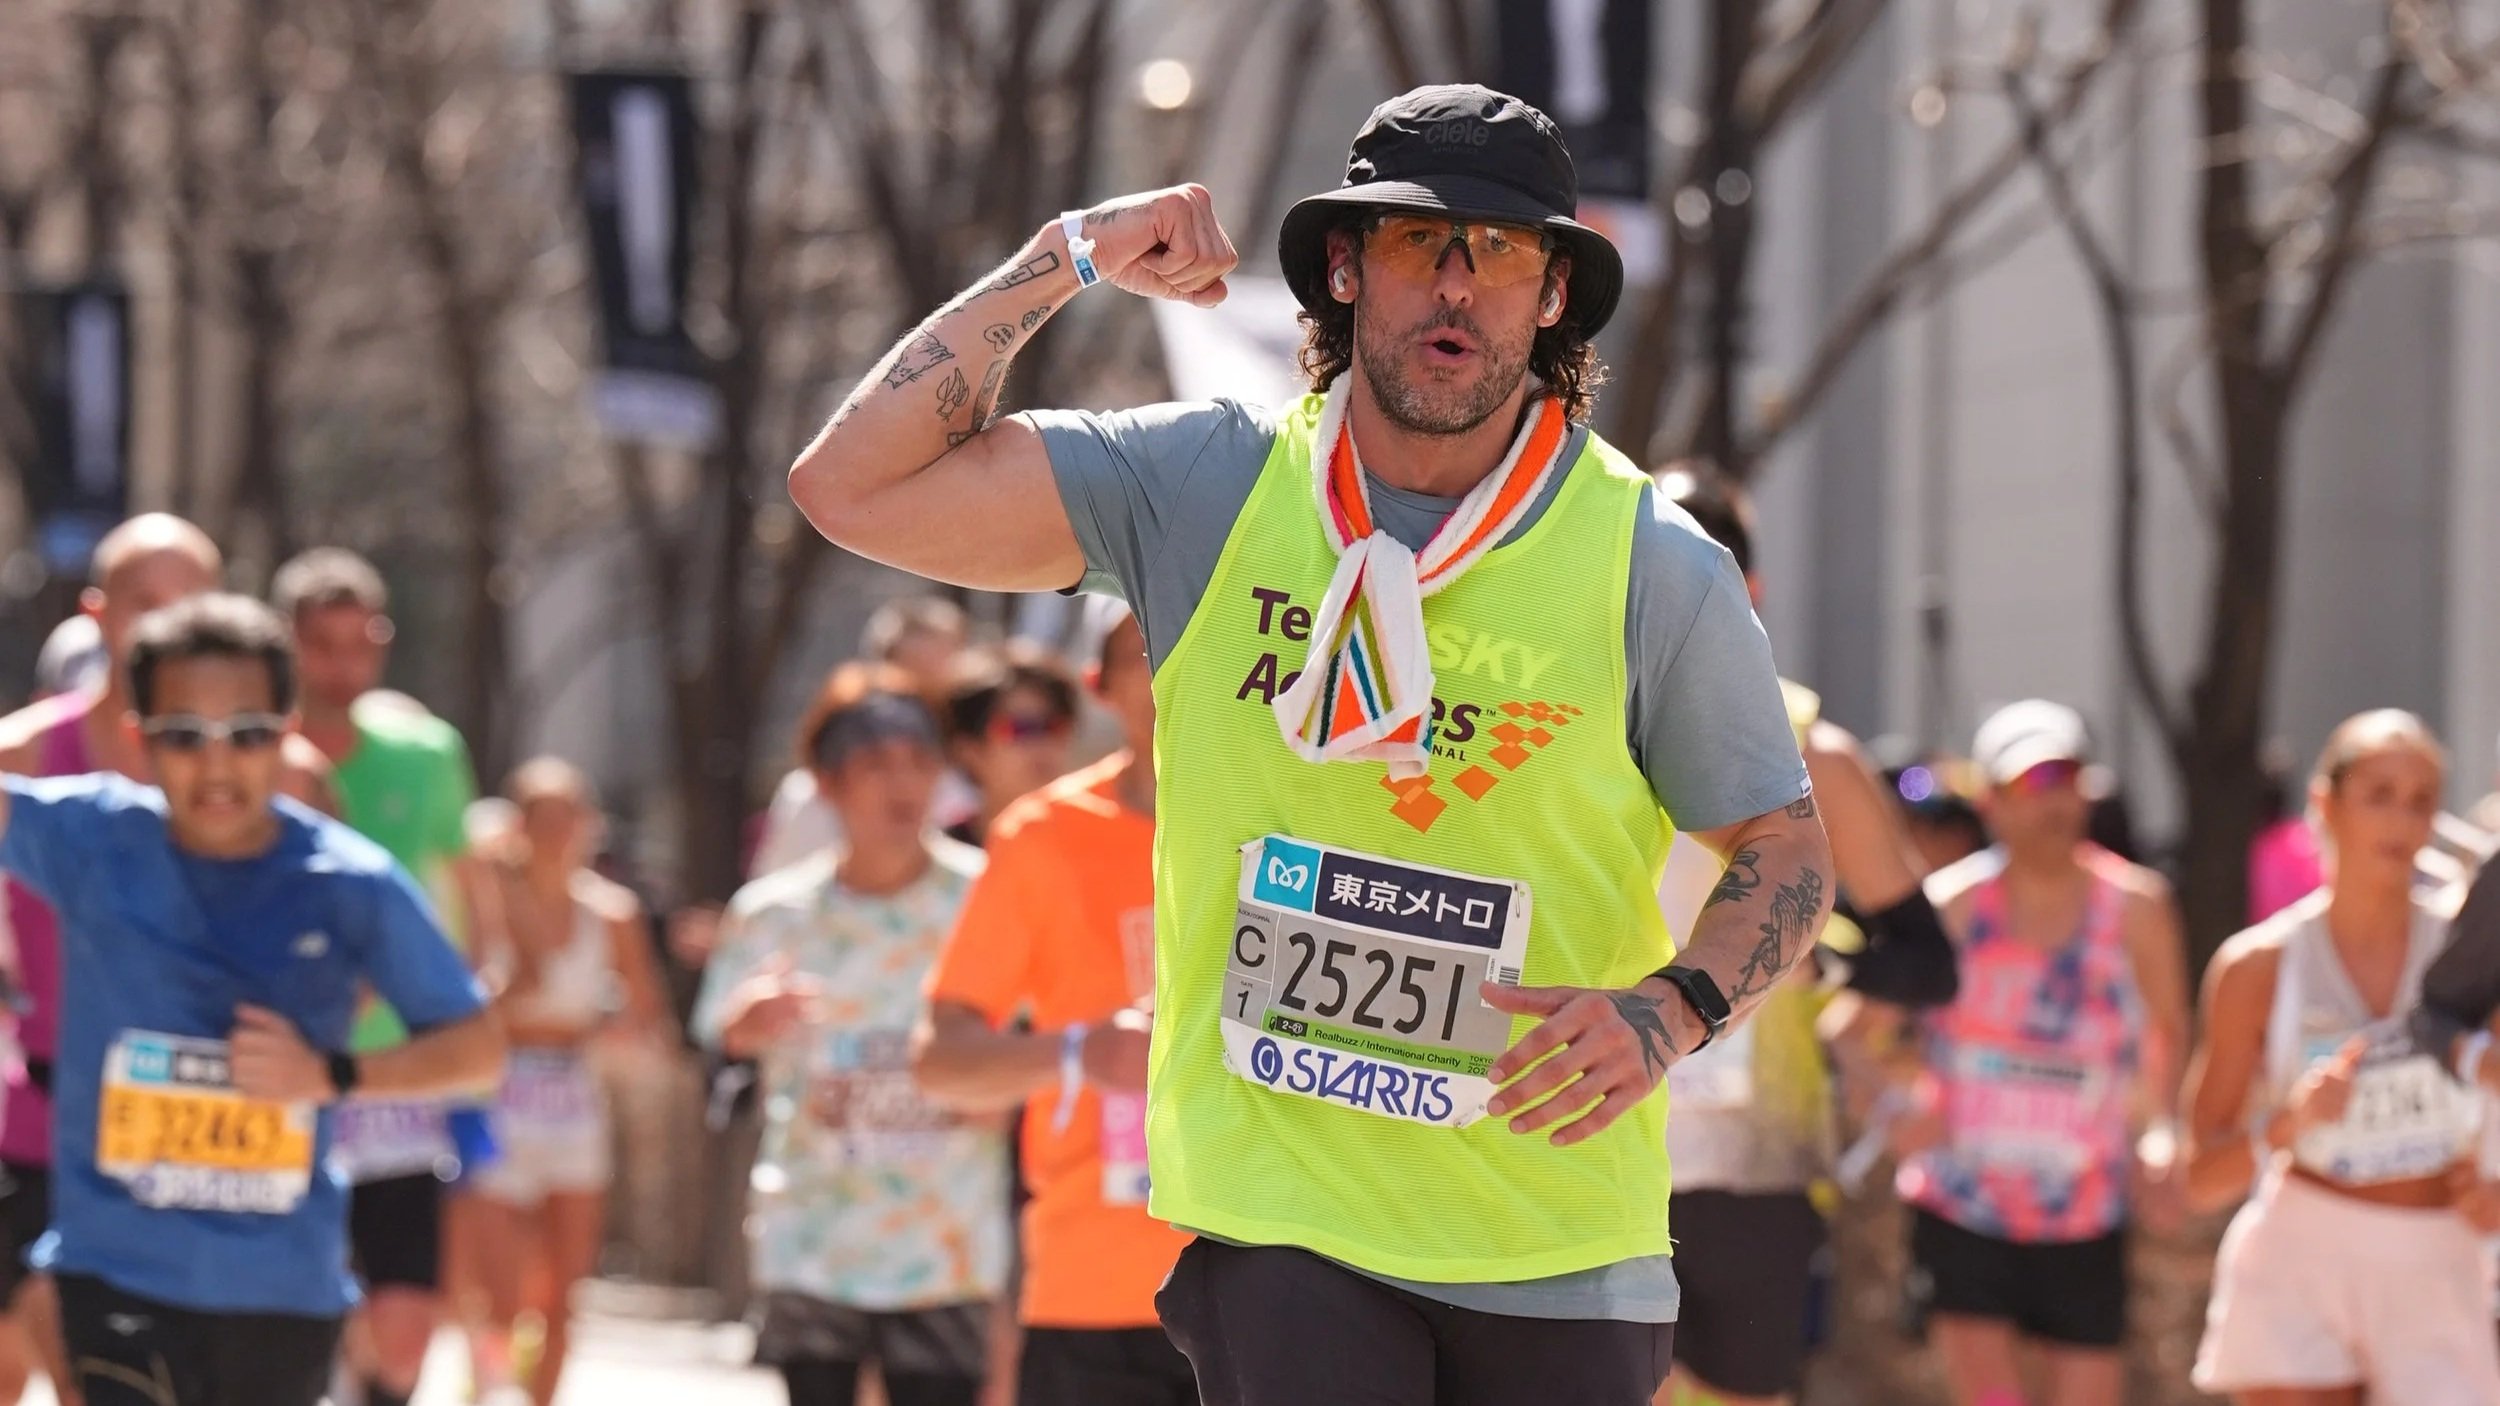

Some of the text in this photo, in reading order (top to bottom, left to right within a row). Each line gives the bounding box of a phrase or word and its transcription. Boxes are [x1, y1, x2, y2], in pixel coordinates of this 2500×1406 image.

[1252, 586, 1312, 641] Te
[1428, 622, 1560, 690] SKY
[1329, 872, 1495, 930] 東京メトロ
[1235, 925, 1266, 968] C
[1237, 990, 1249, 1018] 1
[1279, 932, 1465, 1041] 25251
[1314, 1029, 1359, 1047] Realbuzz
[1366, 1041, 1426, 1061] International
[1426, 1053, 1461, 1068] Charity
